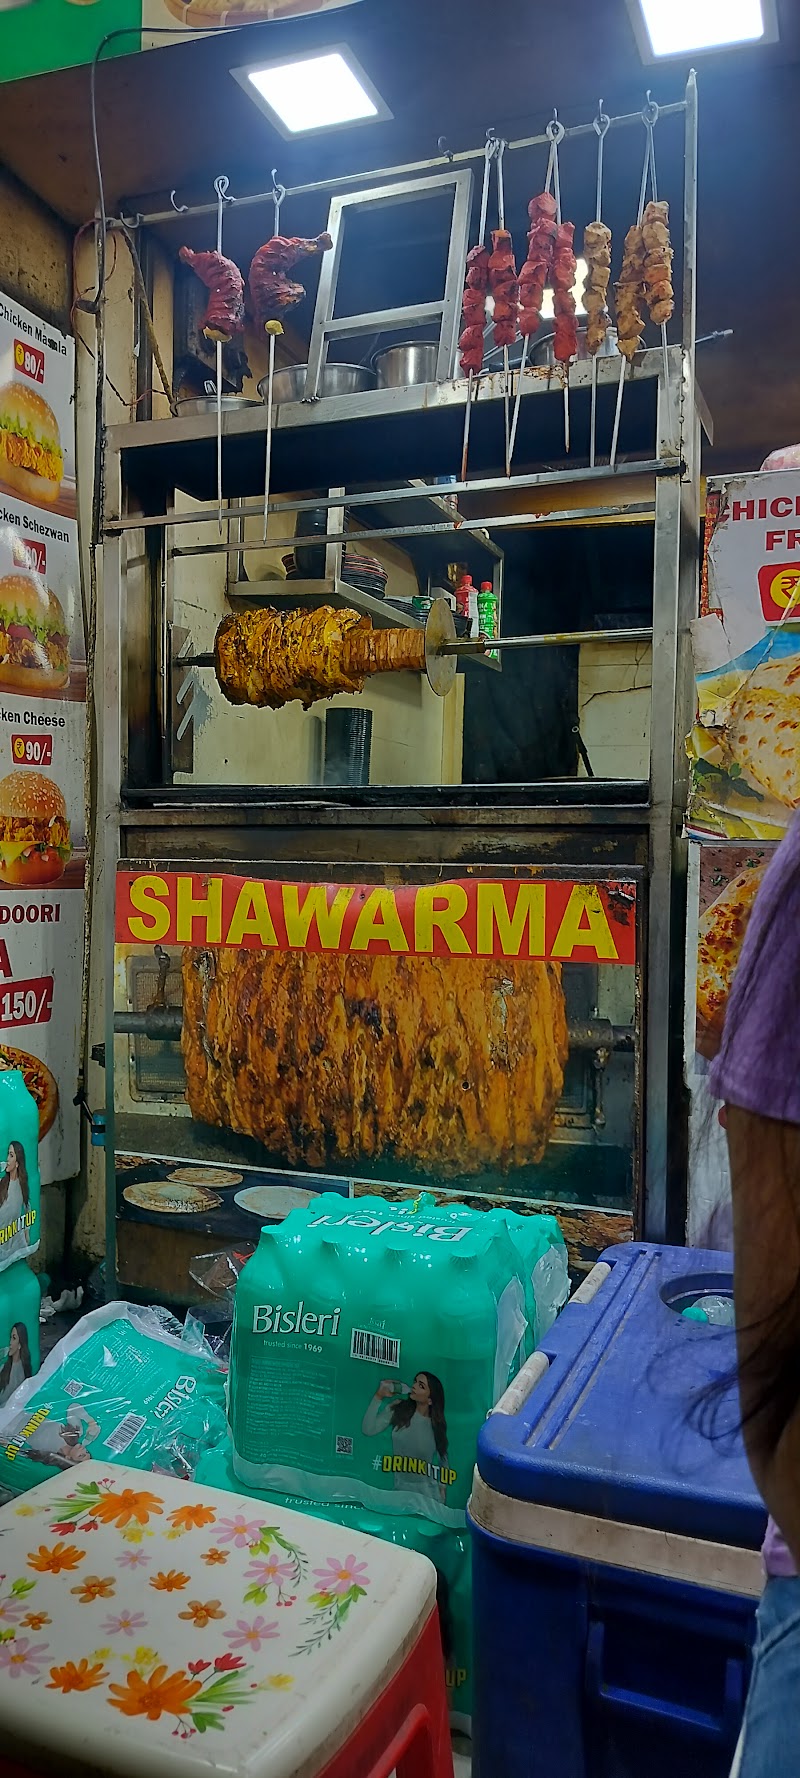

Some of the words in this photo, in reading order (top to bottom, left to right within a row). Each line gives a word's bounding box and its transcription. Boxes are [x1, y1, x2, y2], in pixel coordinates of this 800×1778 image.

[22, 515, 70, 544] Schezwan
[23, 711, 66, 728] Cheese
[127, 874, 619, 960] SHAWARMA
[306, 1214, 474, 1243] Bisleri
[252, 1300, 341, 1336] Bisleri
[263, 1339, 286, 1349] trusted
[303, 1342, 323, 1354] 1969
